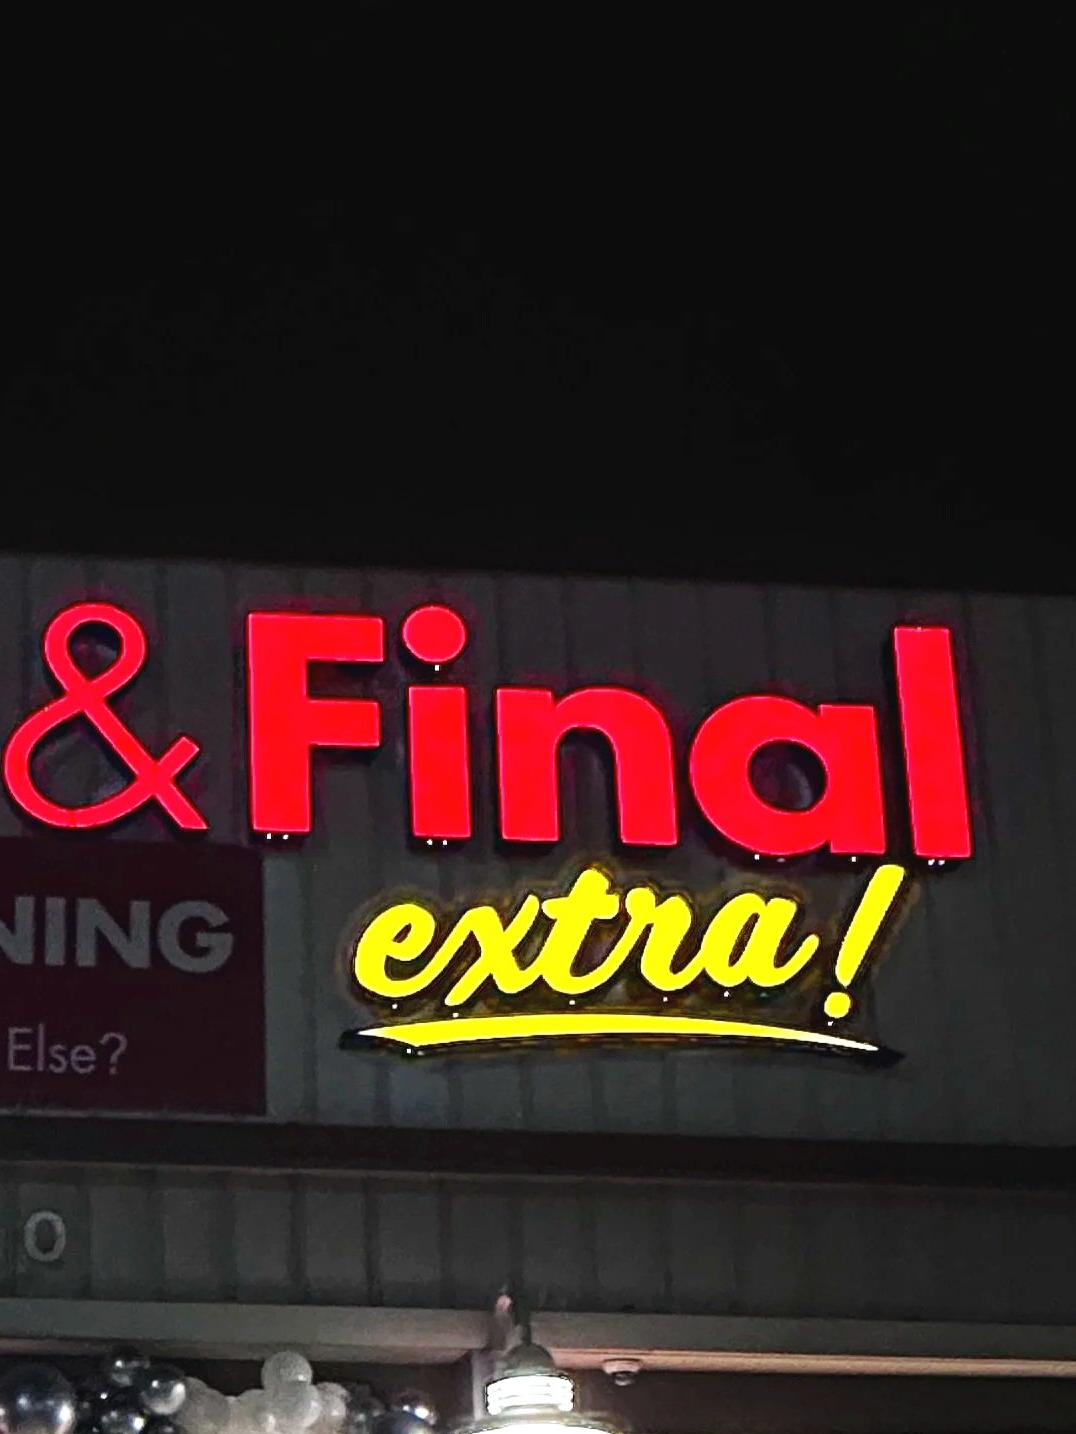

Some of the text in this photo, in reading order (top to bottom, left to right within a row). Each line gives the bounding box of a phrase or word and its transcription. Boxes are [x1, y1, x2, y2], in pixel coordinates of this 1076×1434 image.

[247, 604, 972, 859] Final
[355, 864, 906, 1020] extra!
[7, 1026, 129, 1077] Else?
